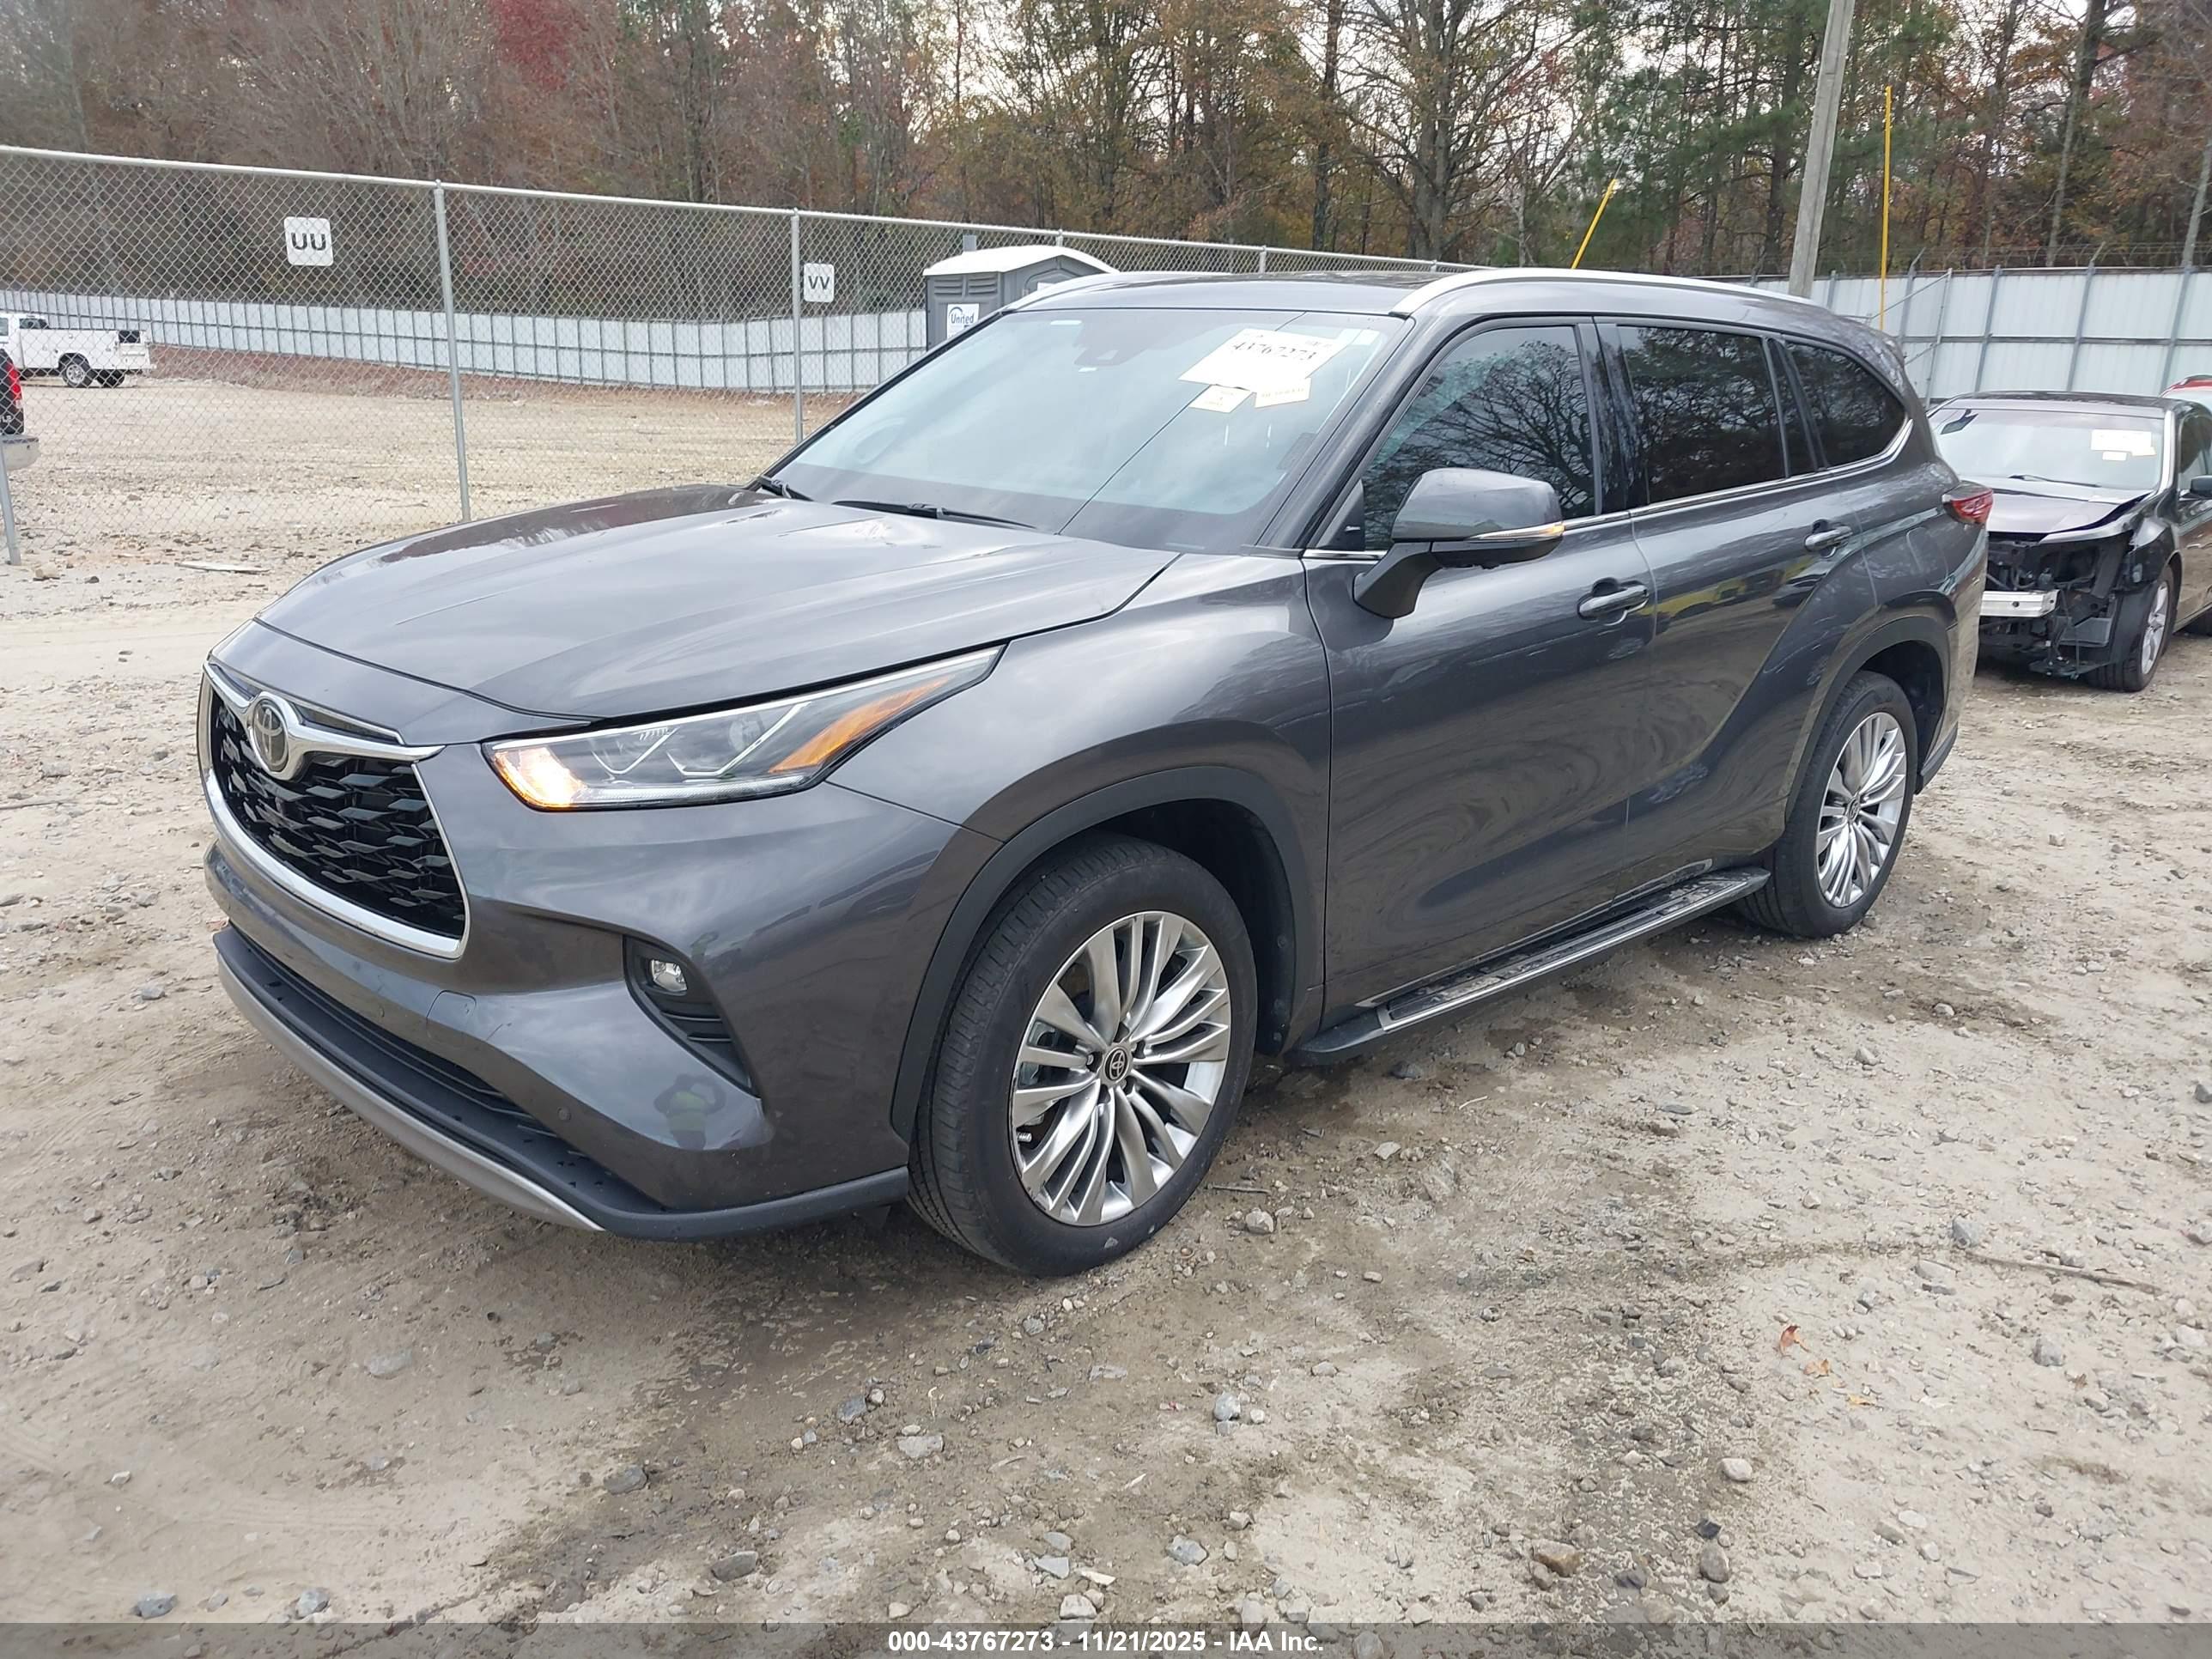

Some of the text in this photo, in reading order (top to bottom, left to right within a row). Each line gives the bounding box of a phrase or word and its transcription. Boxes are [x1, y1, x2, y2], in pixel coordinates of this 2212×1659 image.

[290, 233, 326, 251] UU
[808, 276, 830, 290] VV
[951, 313, 975, 324] United
